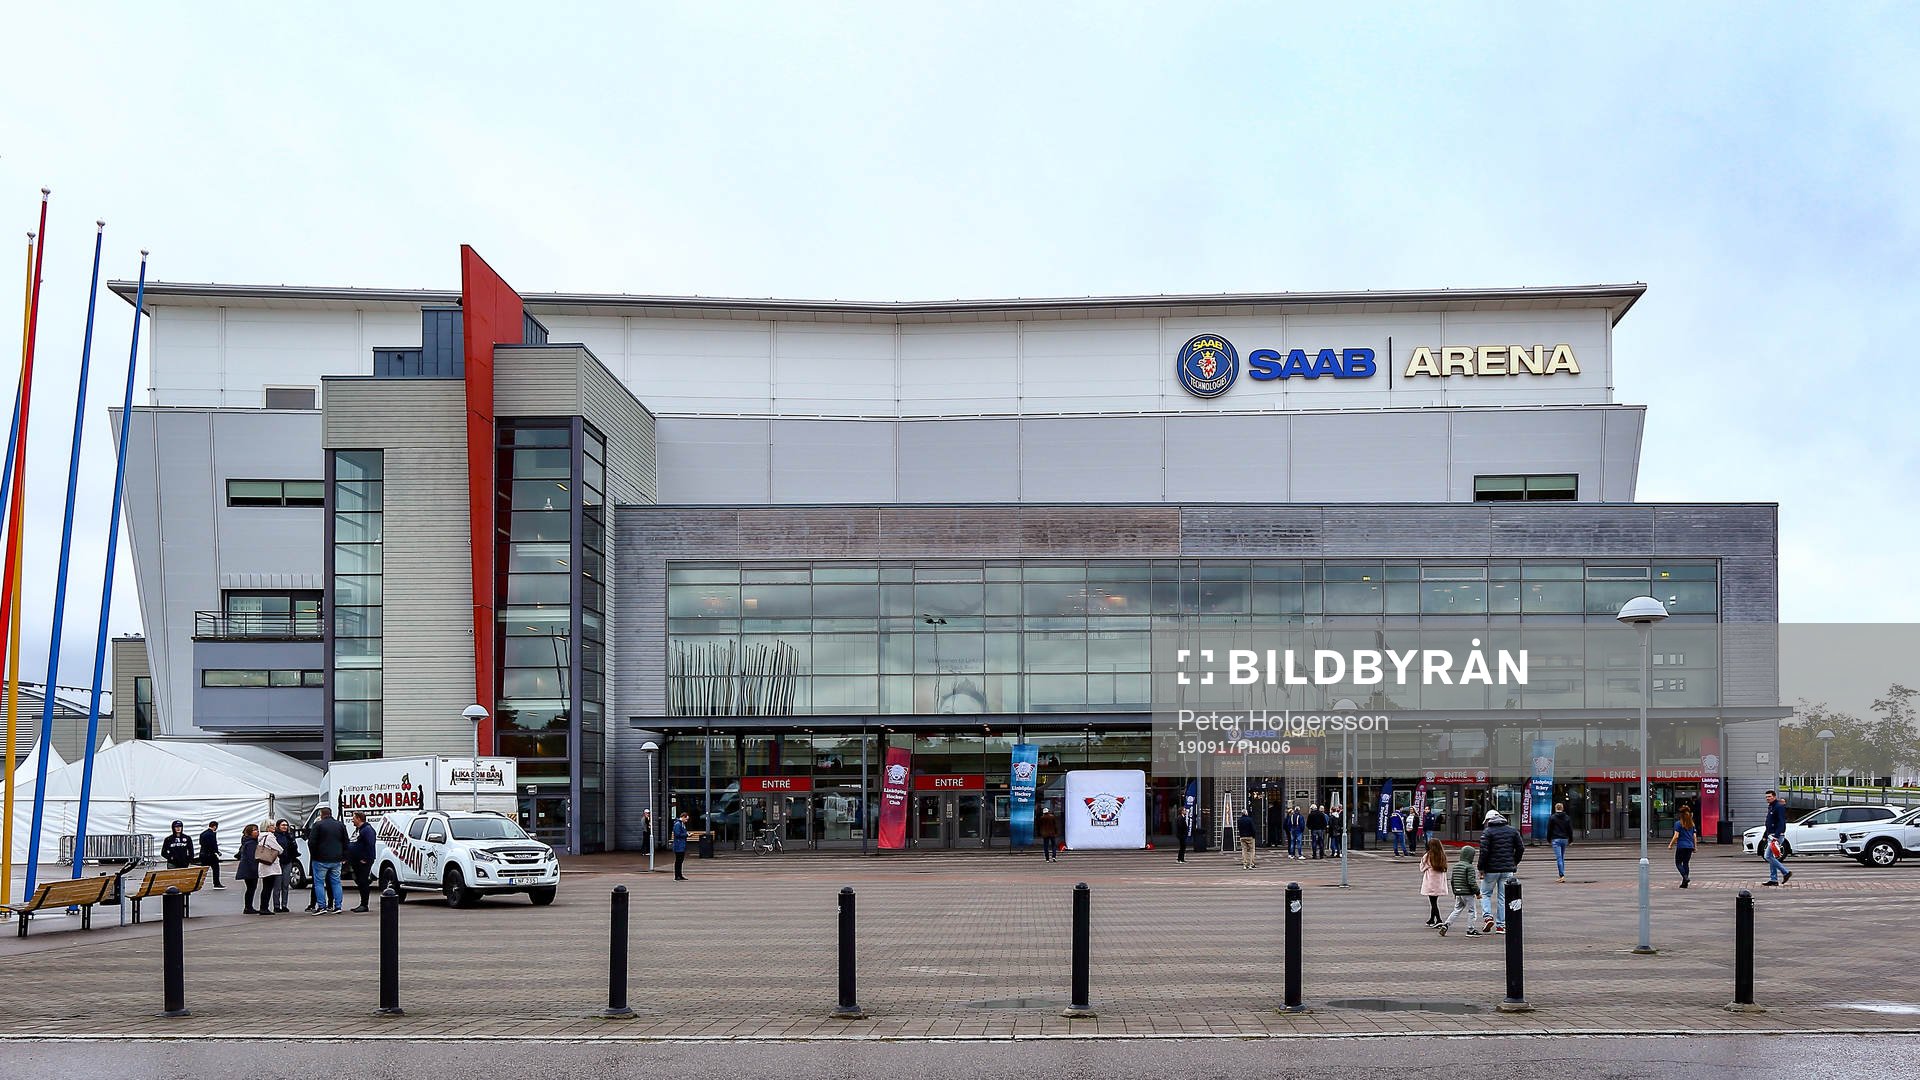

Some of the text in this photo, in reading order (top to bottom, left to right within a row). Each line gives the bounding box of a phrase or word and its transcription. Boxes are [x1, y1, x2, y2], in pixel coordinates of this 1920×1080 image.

[1193, 339, 1223, 351] SAAB
[1248, 343, 1581, 381] SAAB ARENA
[1244, 729, 1276, 738] SAAB
[1443, 769, 1468, 779] ENTRÉ
[1609, 769, 1637, 779] ENTRÉ
[762, 778, 791, 789] ENTRÉ
[935, 776, 964, 787] ENTRÉ
[343, 794, 367, 809] LIKA
[368, 792, 393, 808] SOM
